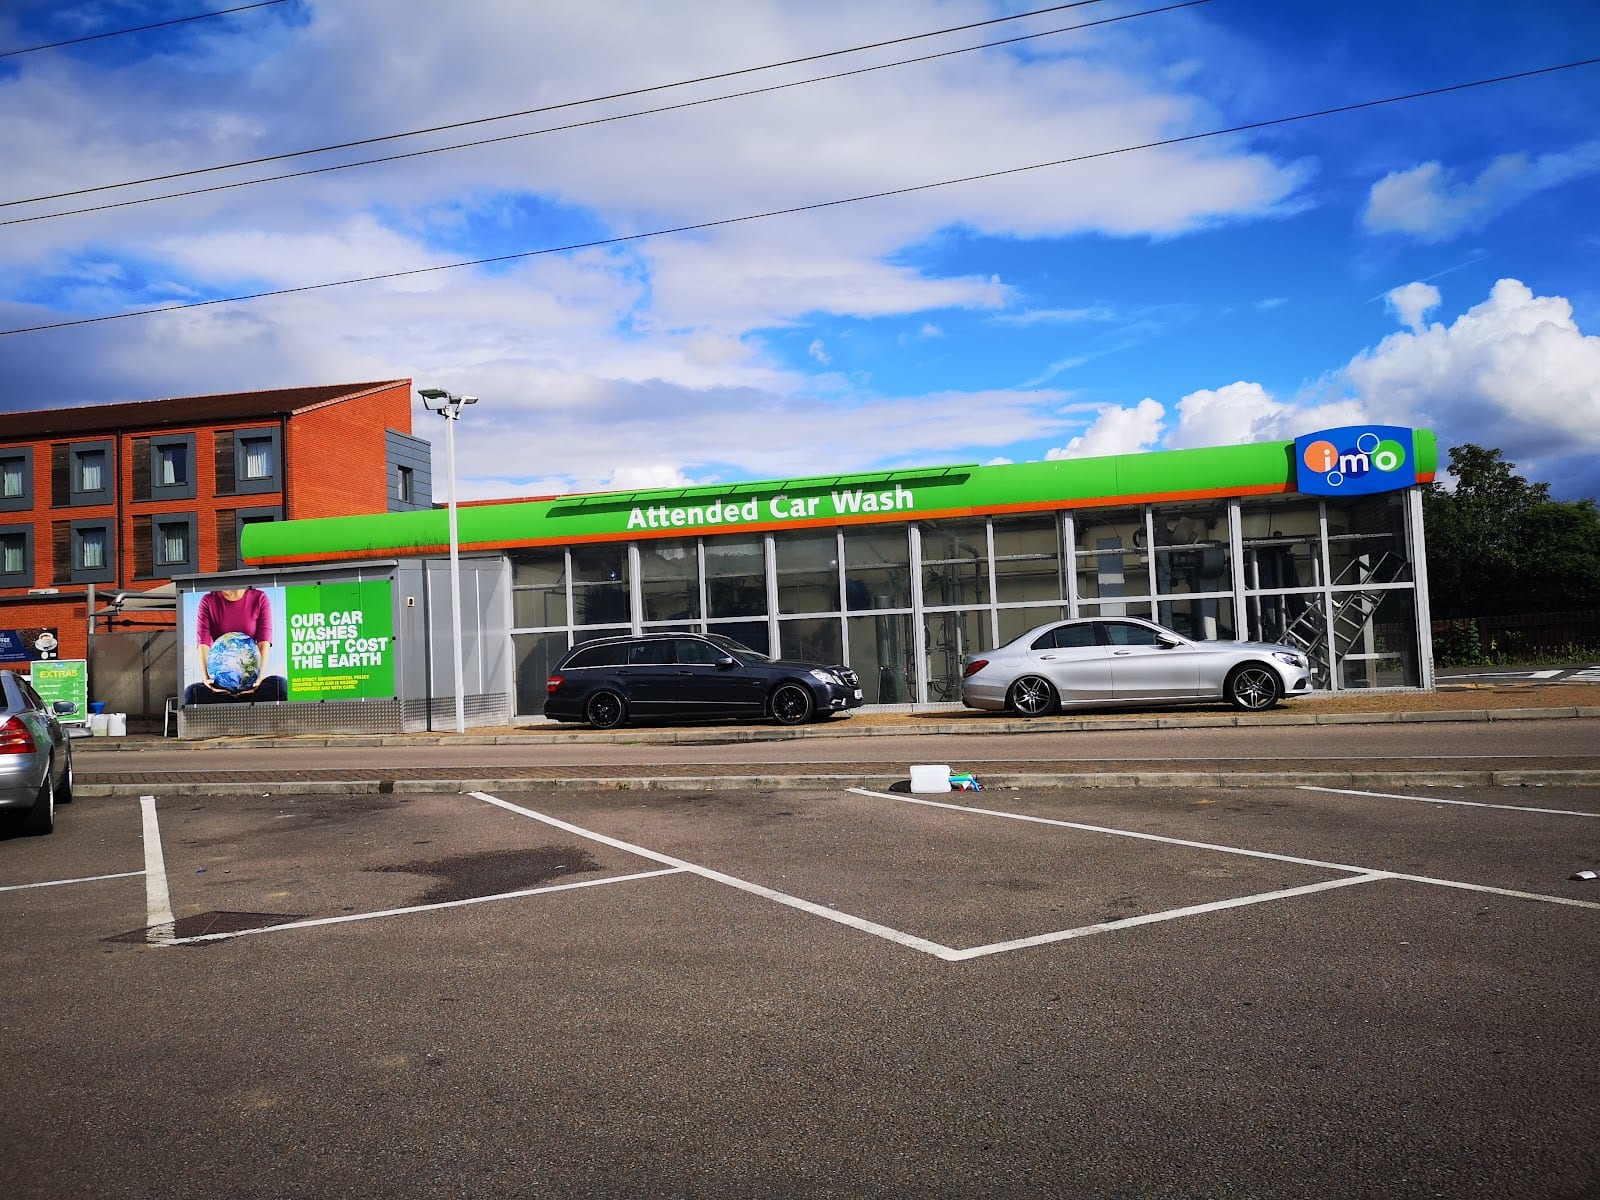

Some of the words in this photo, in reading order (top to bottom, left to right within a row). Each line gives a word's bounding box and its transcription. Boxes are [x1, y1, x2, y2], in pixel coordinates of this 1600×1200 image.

[1323, 448, 1397, 473] imo
[626, 496, 759, 529] Attended
[769, 494, 820, 519] Car
[831, 484, 914, 514] Wash
[291, 613, 325, 627] OUR
[329, 611, 363, 625] CAR
[290, 625, 358, 641] WASHES
[291, 640, 340, 656] DON'T
[344, 637, 388, 653] COST
[291, 655, 324, 669] THE
[328, 652, 382, 668] EARTH
[39, 669, 79, 678] EXTRAS
